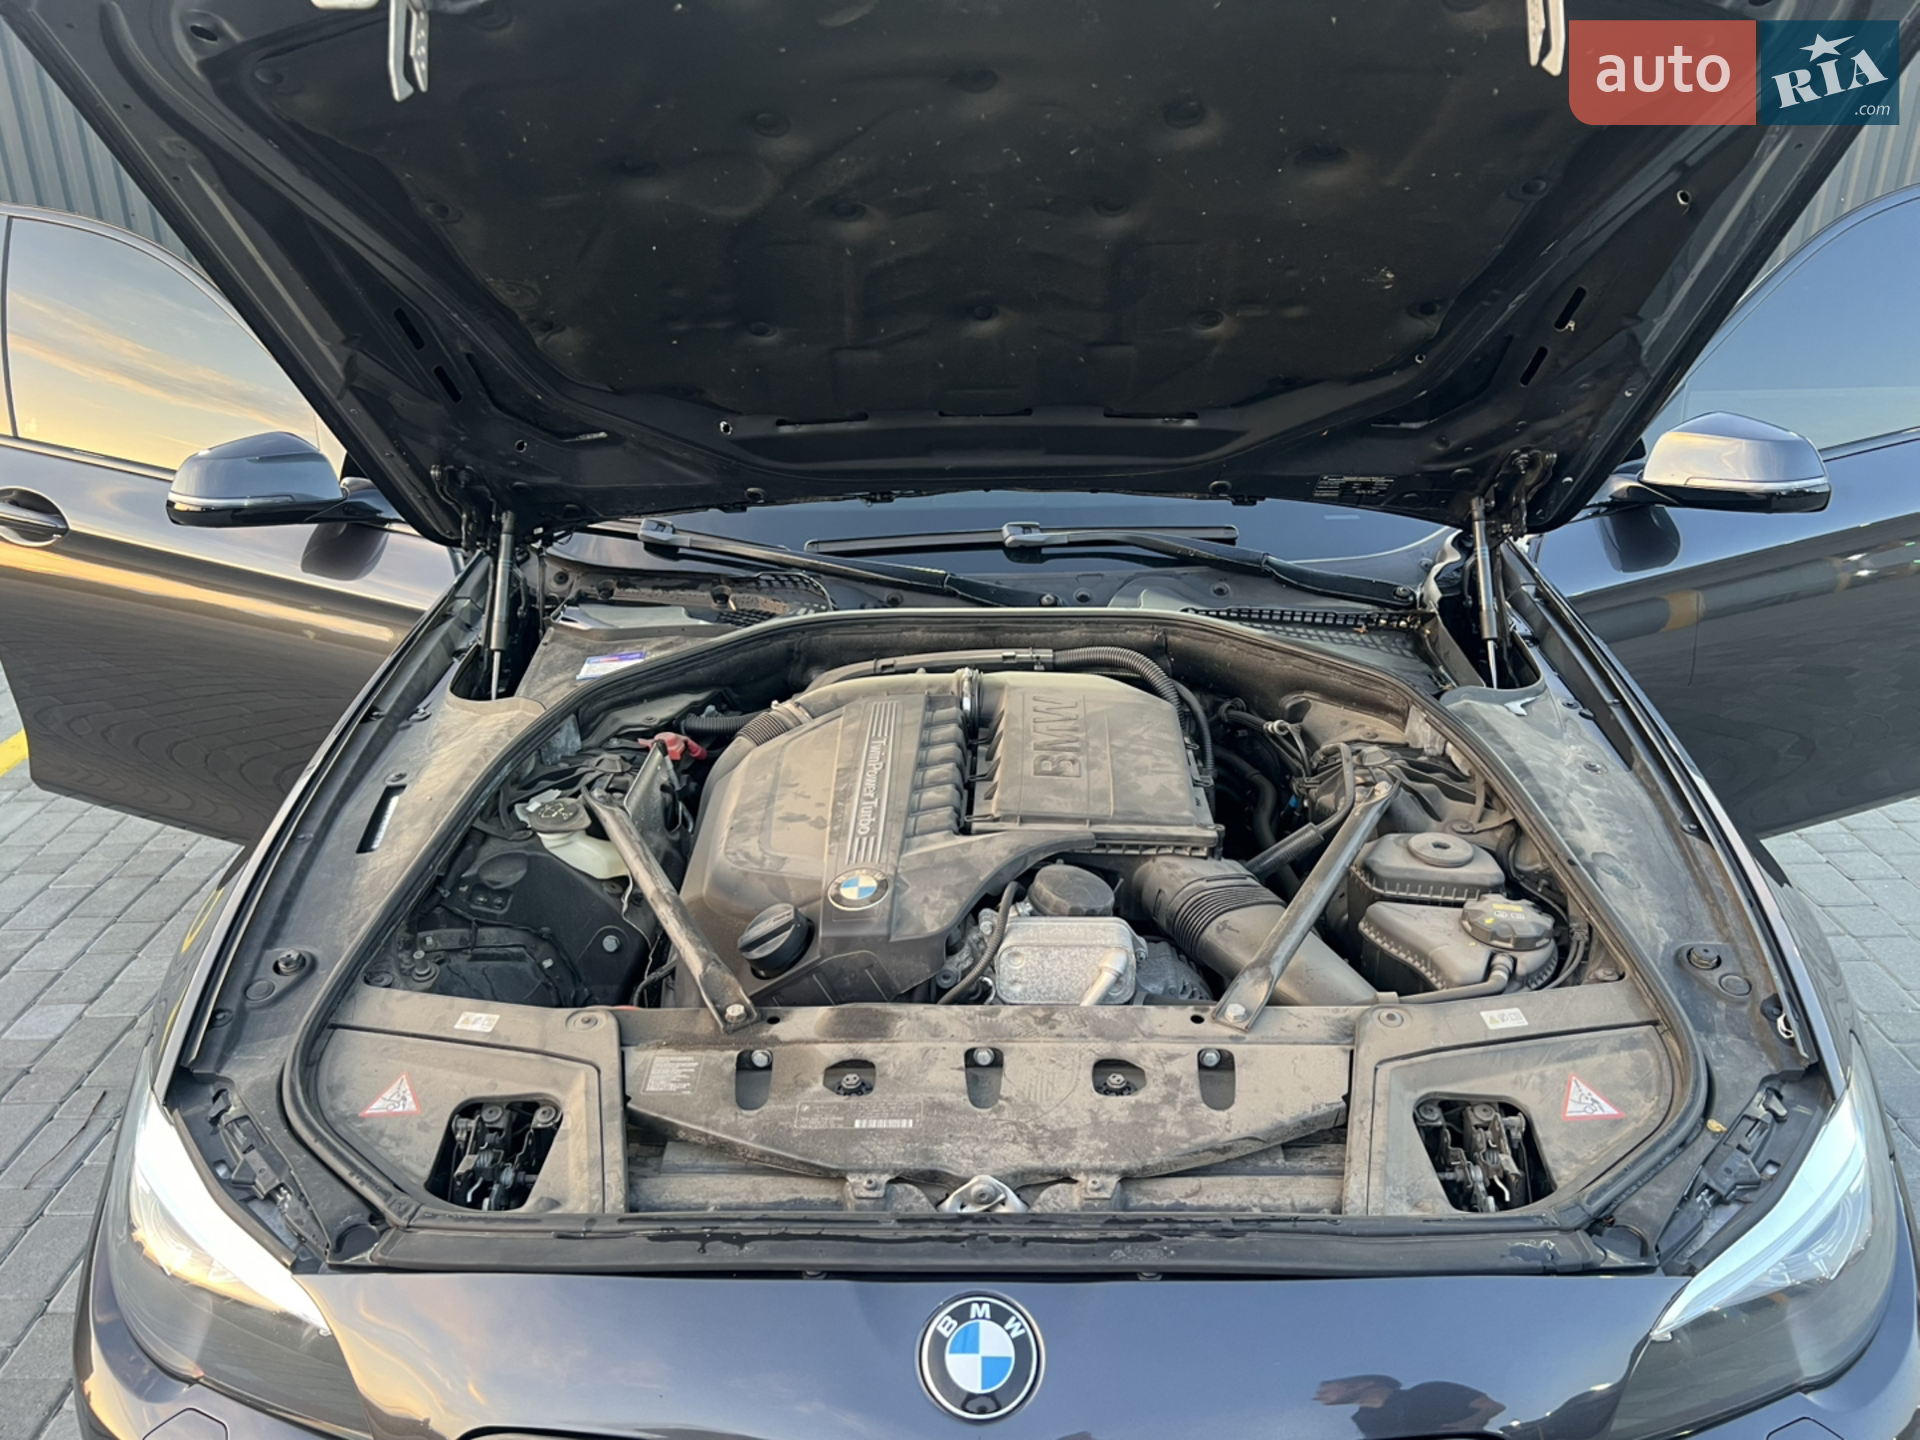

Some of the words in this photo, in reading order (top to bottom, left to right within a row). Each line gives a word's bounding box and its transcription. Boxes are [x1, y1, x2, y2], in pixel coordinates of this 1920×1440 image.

[1032, 695, 1082, 778] BMW
[863, 737, 888, 799] TwinPower
[857, 797, 879, 836] Turbo
[936, 1302, 1026, 1339] BMW
